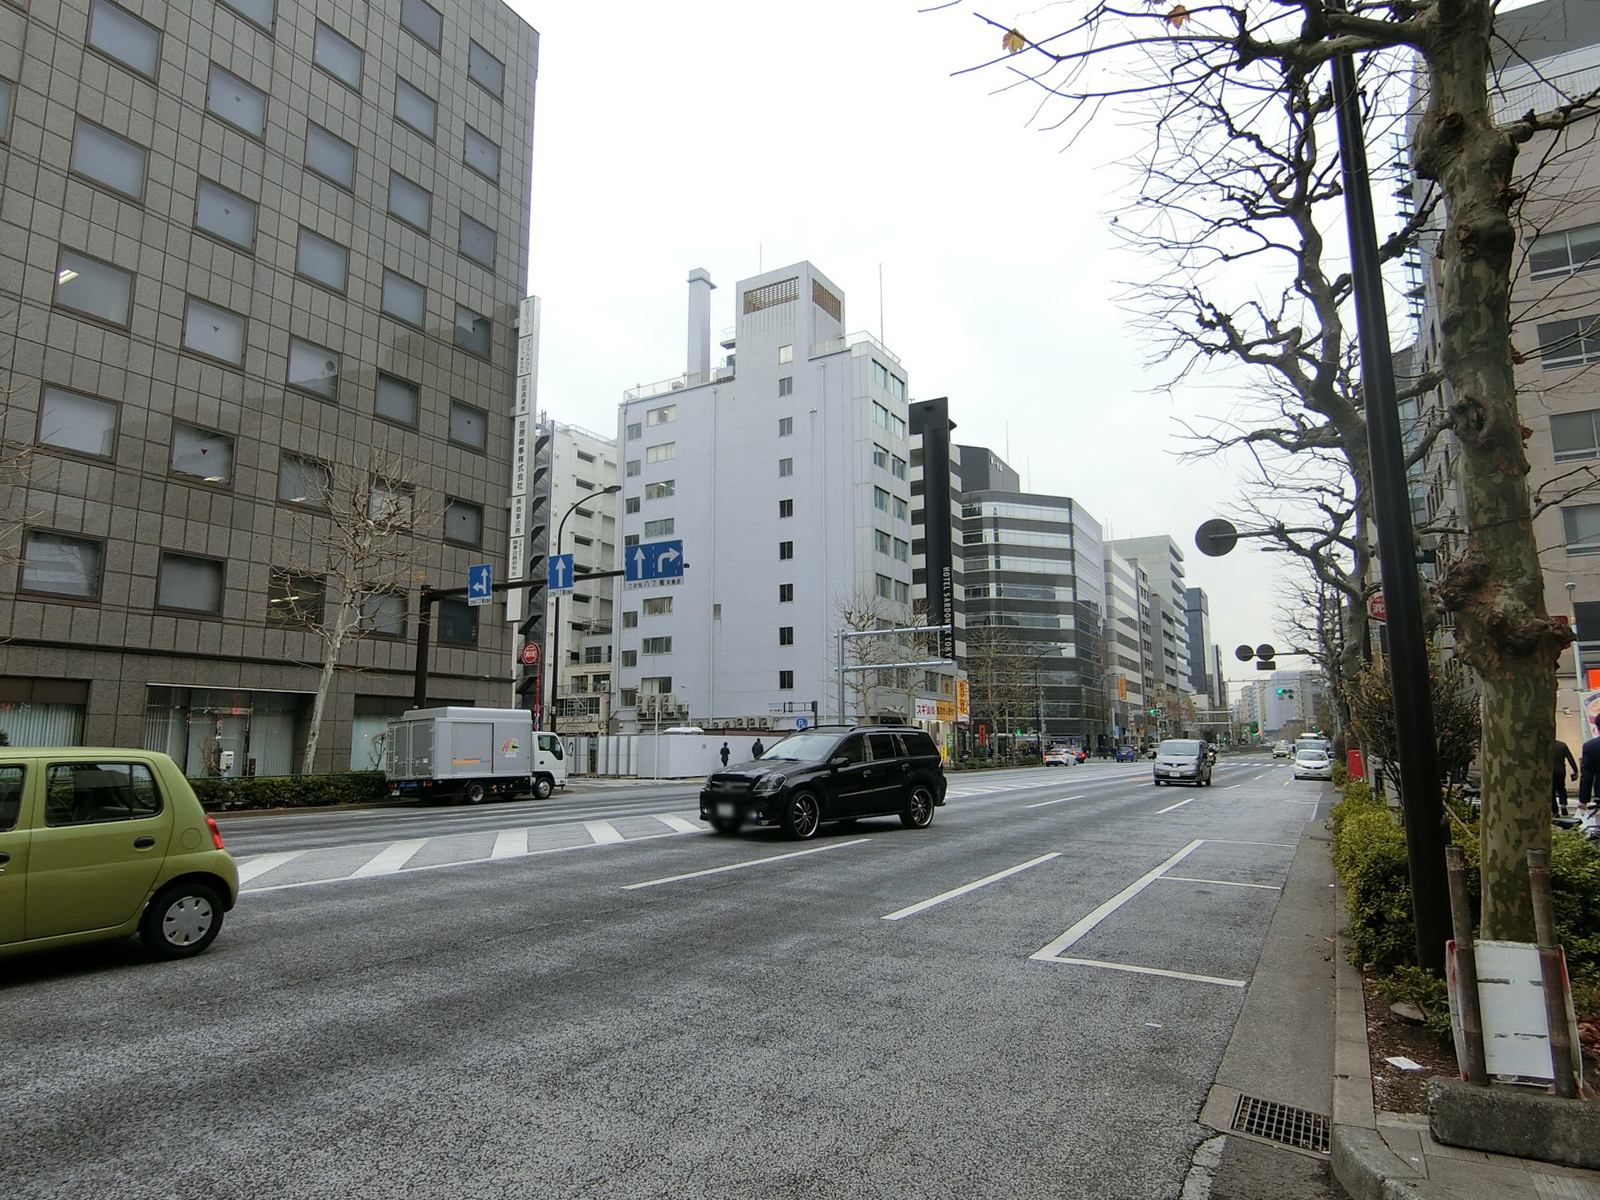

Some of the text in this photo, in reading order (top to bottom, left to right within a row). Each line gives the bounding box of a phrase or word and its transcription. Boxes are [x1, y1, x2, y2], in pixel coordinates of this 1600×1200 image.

[942, 566, 953, 658] HOTEL SARDONX TOKY
